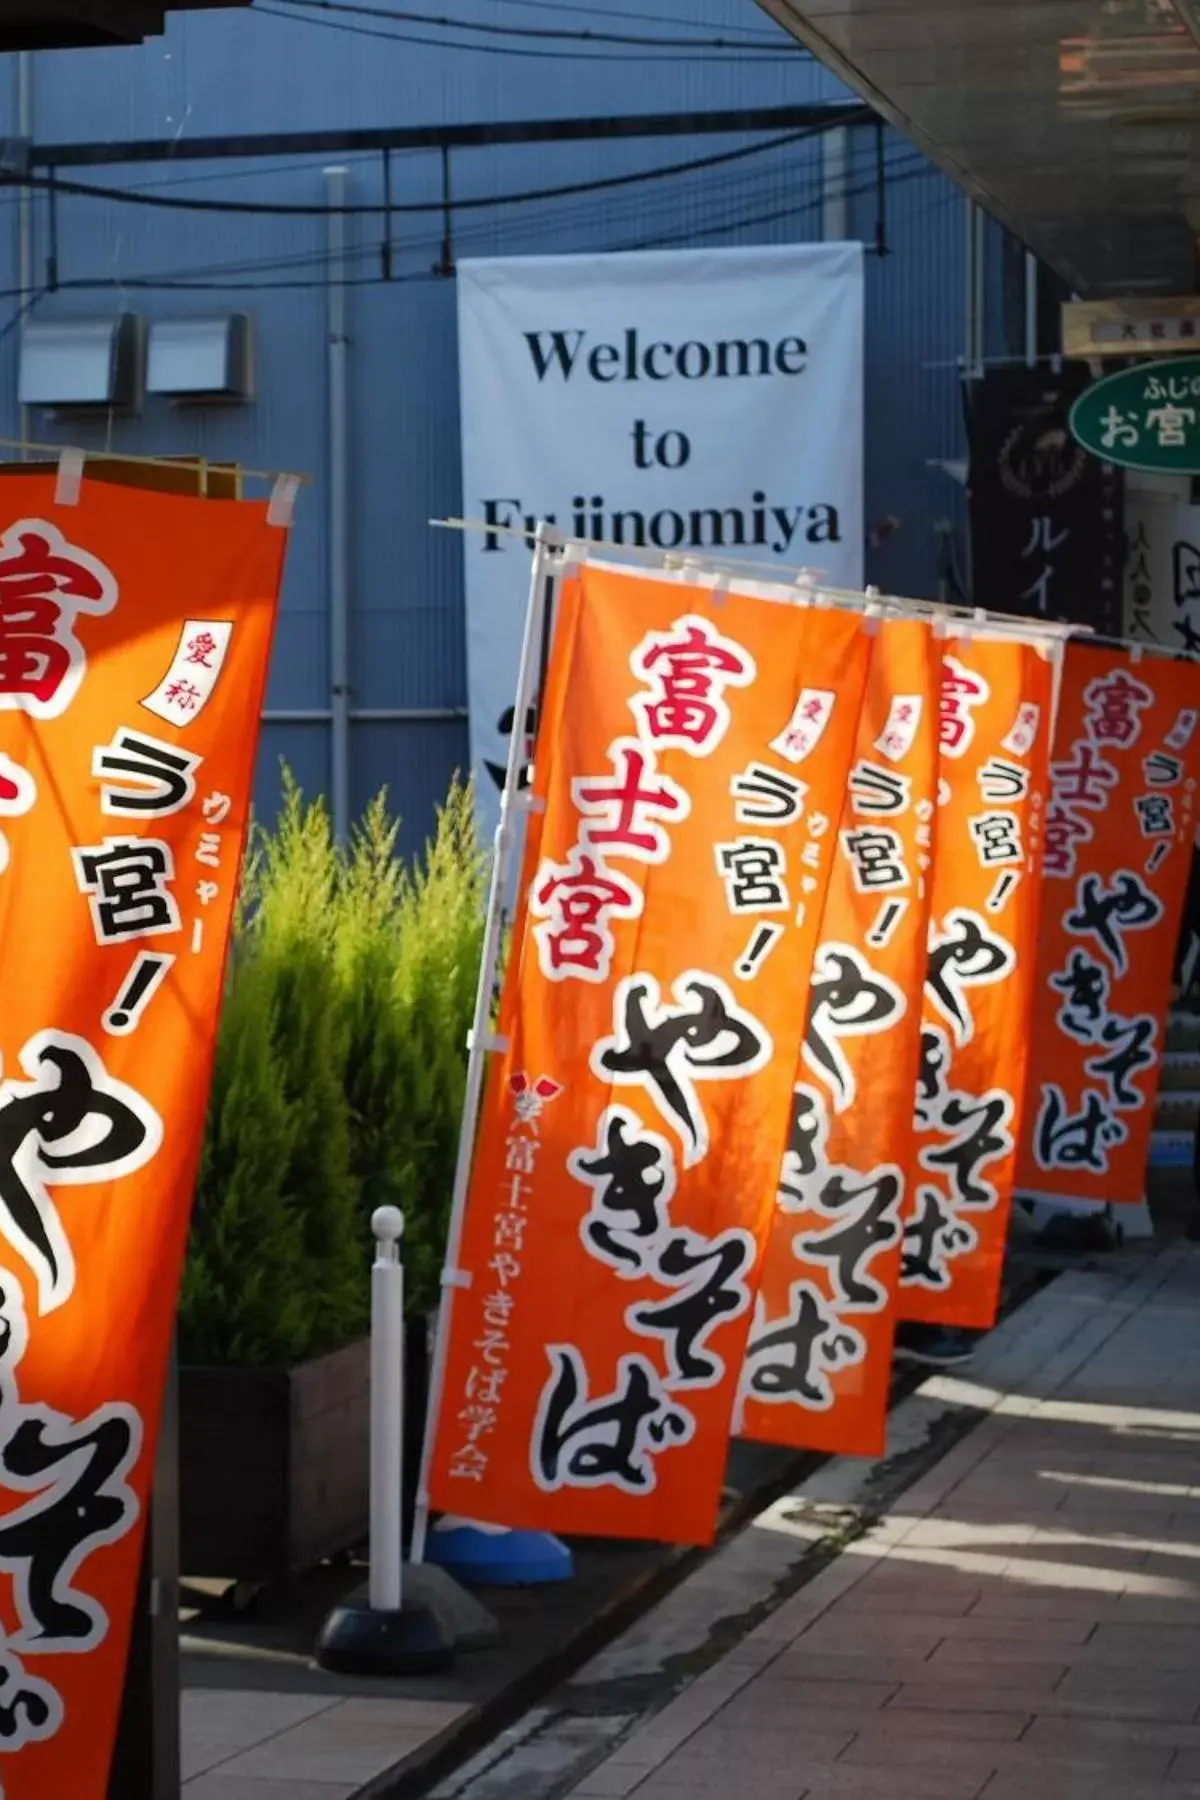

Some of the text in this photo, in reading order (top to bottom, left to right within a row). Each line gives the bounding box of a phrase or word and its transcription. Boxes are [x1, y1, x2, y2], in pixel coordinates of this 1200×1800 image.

[522, 327, 808, 383] Welcome
[629, 418, 691, 470] to
[1099, 401, 1200, 448] お宮
[1017, 514, 1073, 622] ルイ
[531, 615, 757, 983] 富士宮
[1033, 868, 1166, 1174] やきそば
[530, 970, 773, 1492] やきそば
